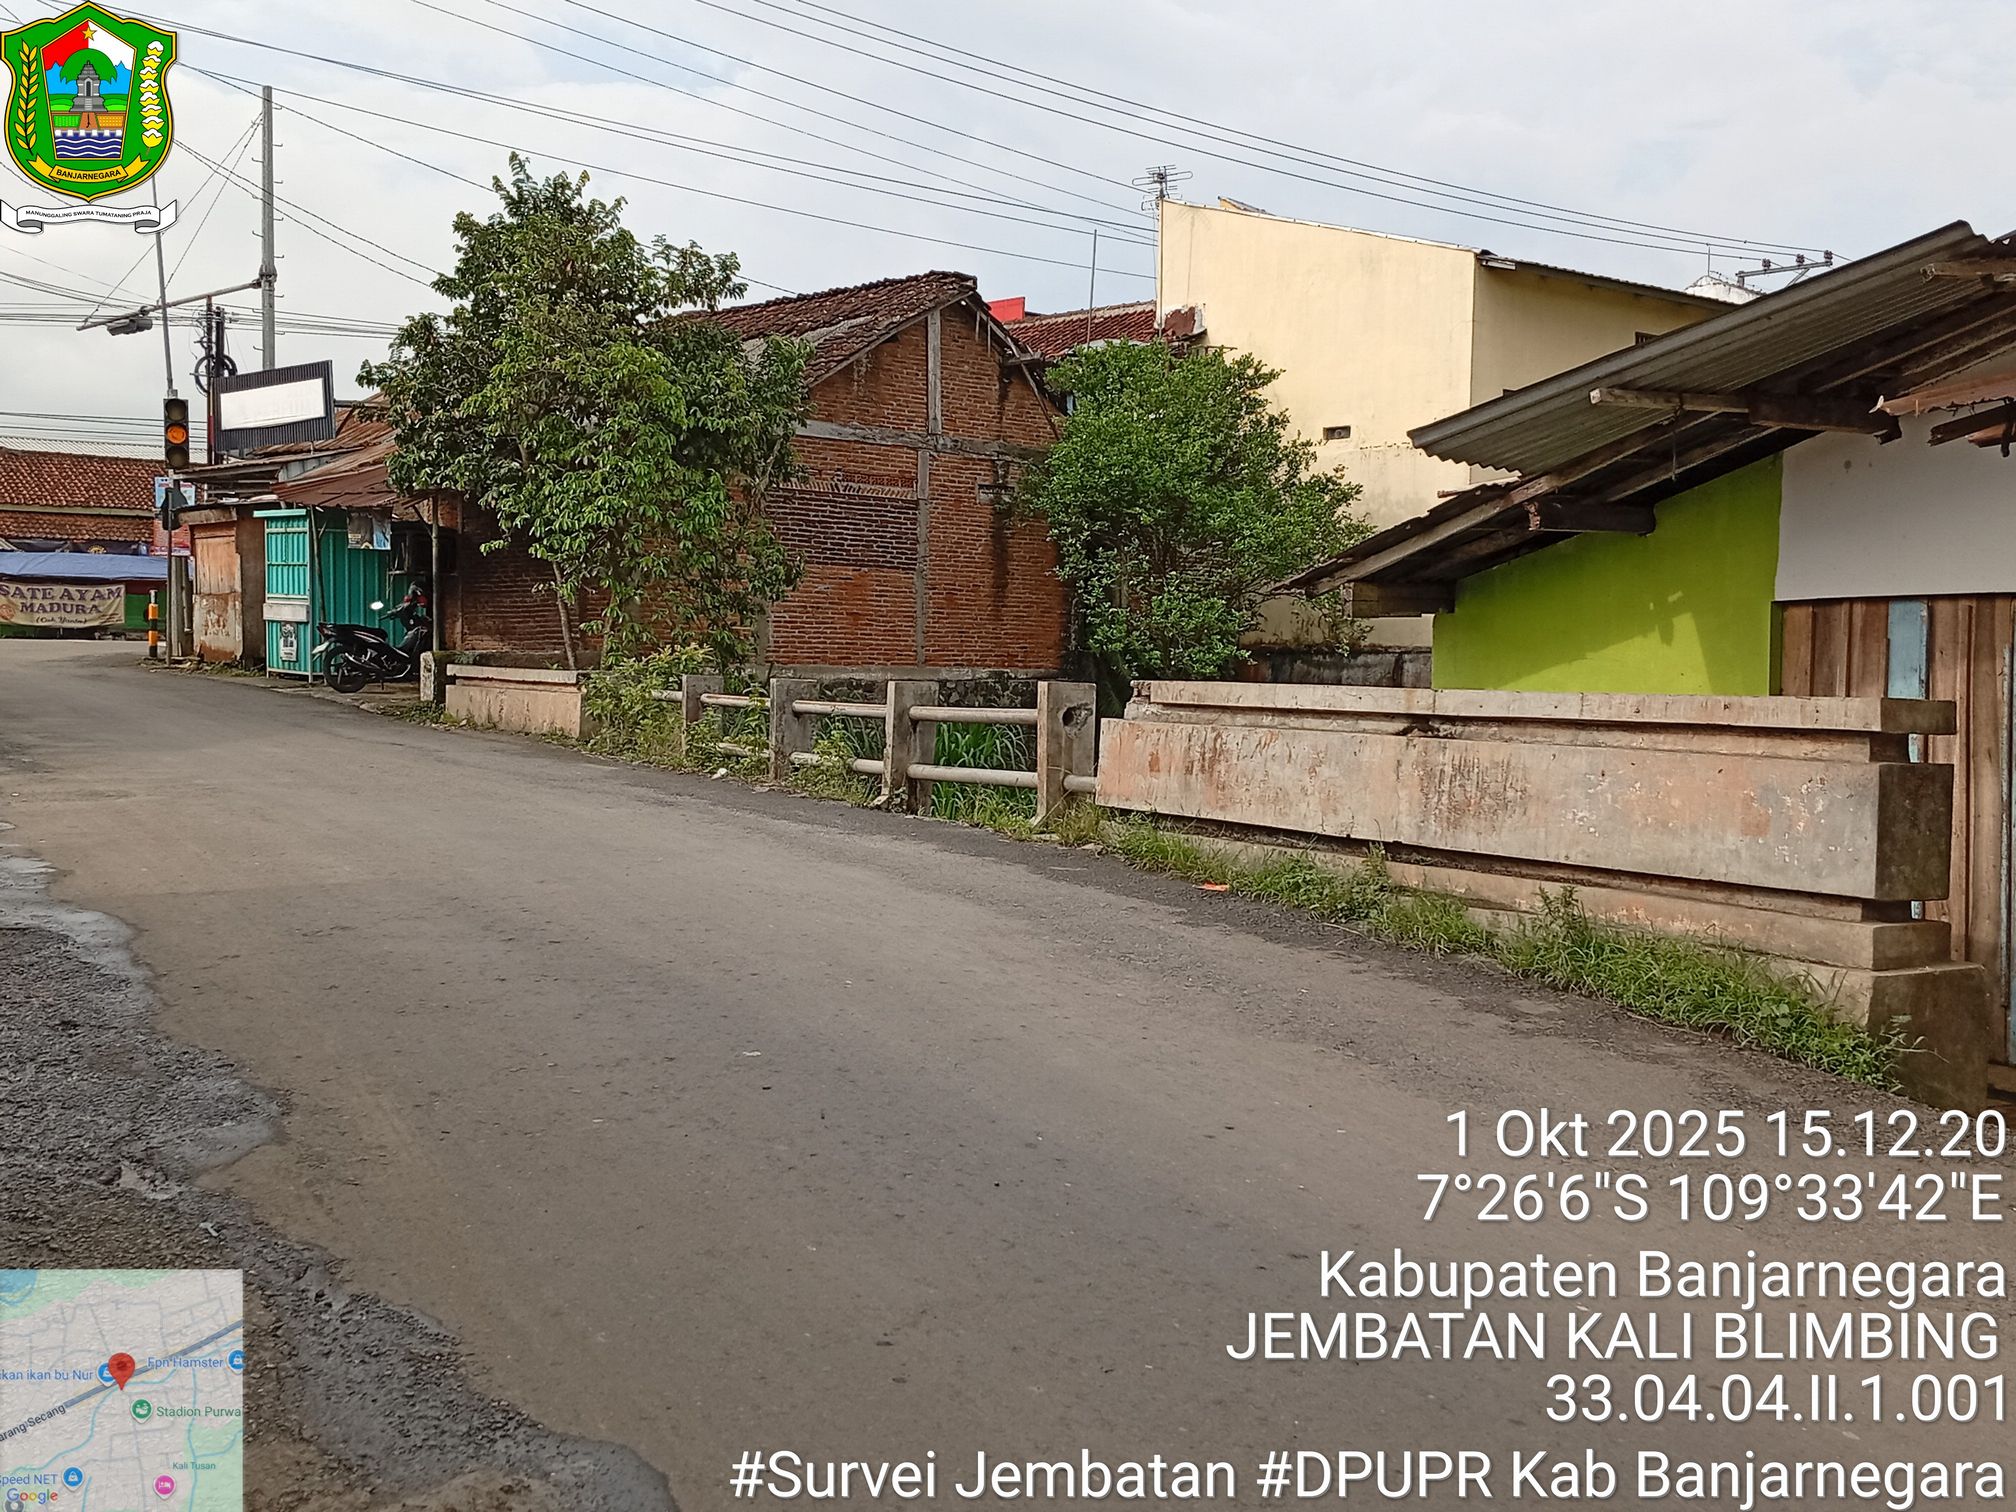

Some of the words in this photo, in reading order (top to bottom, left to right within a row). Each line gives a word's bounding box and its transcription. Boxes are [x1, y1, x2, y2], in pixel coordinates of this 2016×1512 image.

[0, 584, 54, 600] SATE
[59, 586, 122, 601] AYAM
[20, 601, 102, 614] MADURA
